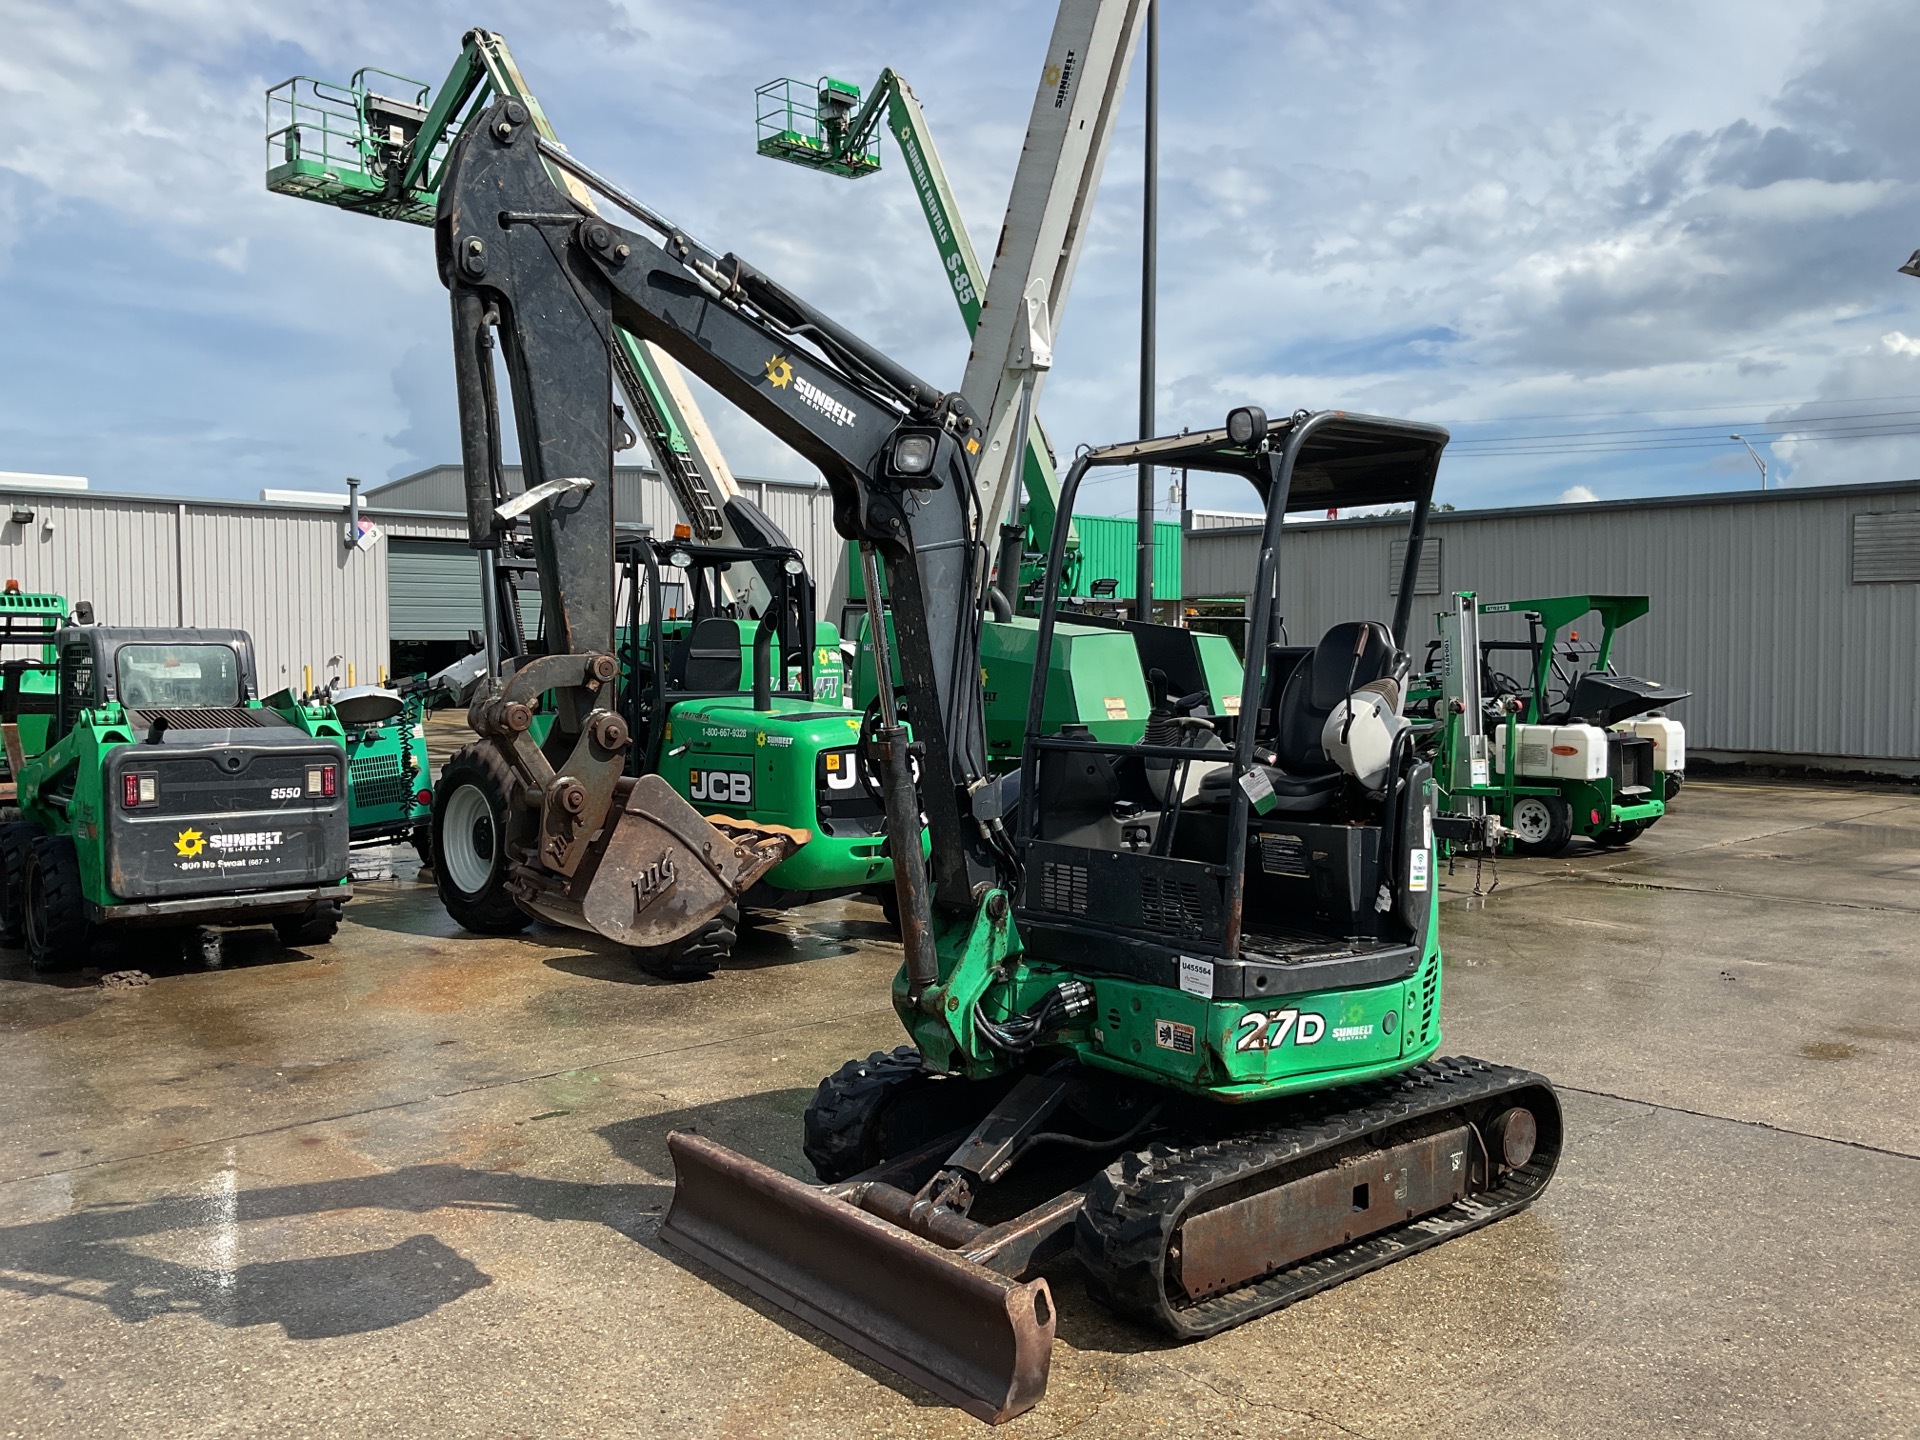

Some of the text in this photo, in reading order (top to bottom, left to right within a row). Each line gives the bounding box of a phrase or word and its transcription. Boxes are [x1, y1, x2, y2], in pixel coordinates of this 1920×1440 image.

[1055, 50, 1075, 108] SUNBELT
[906, 139, 950, 244] SUNBELT RENTALS
[946, 252, 975, 305] S-85
[793, 376, 857, 426] SUNBELT
[799, 394, 843, 427] RENTALS
[371, 530, 377, 538] 3
[702, 727, 747, 738] 1-800-667-9328
[766, 735, 794, 745] SUNBELT
[270, 787, 301, 800] S550
[690, 771, 752, 803] JCB
[209, 831, 284, 848] SUNBELT
[1182, 961, 1212, 976] U455564
[1236, 1008, 1327, 1053] 27D
[1331, 1024, 1374, 1038] SUNBELT
